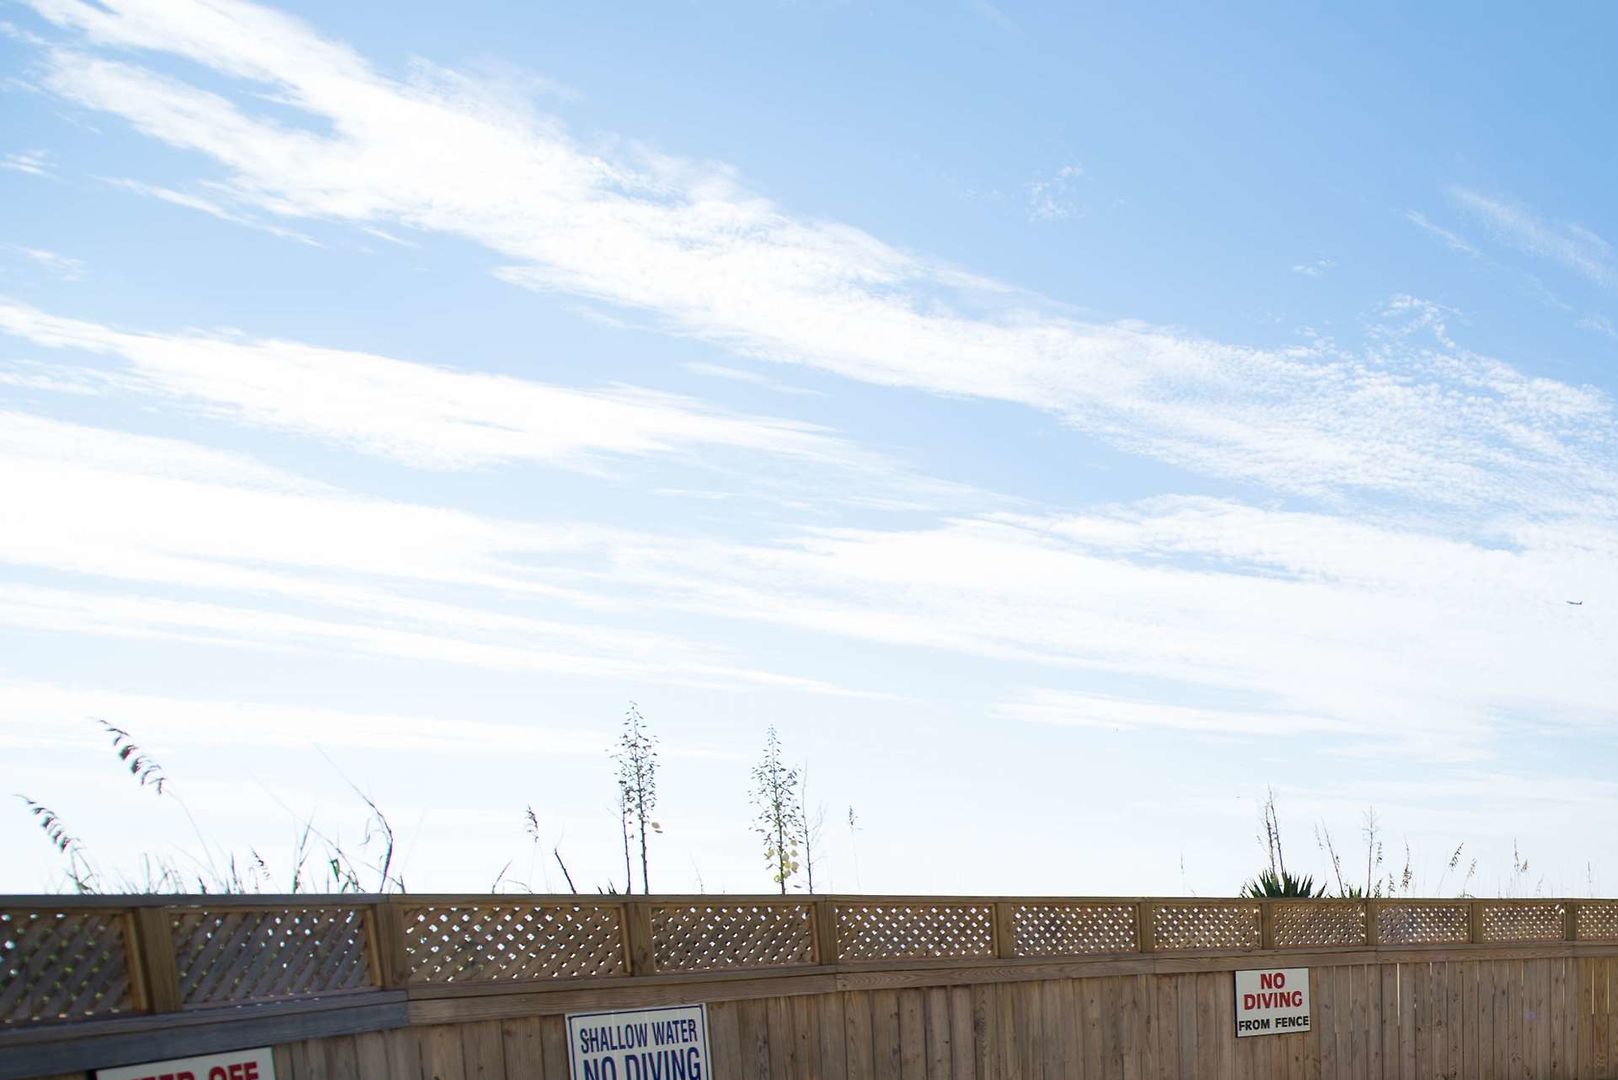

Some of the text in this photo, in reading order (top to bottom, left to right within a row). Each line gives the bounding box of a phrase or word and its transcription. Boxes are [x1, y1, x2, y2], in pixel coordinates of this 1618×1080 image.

[1260, 973, 1285, 989] NO
[1244, 991, 1302, 1010] DIVING
[1239, 1016, 1309, 1031] FROM FENCE
[580, 1019, 697, 1053] SHALLOW WATER
